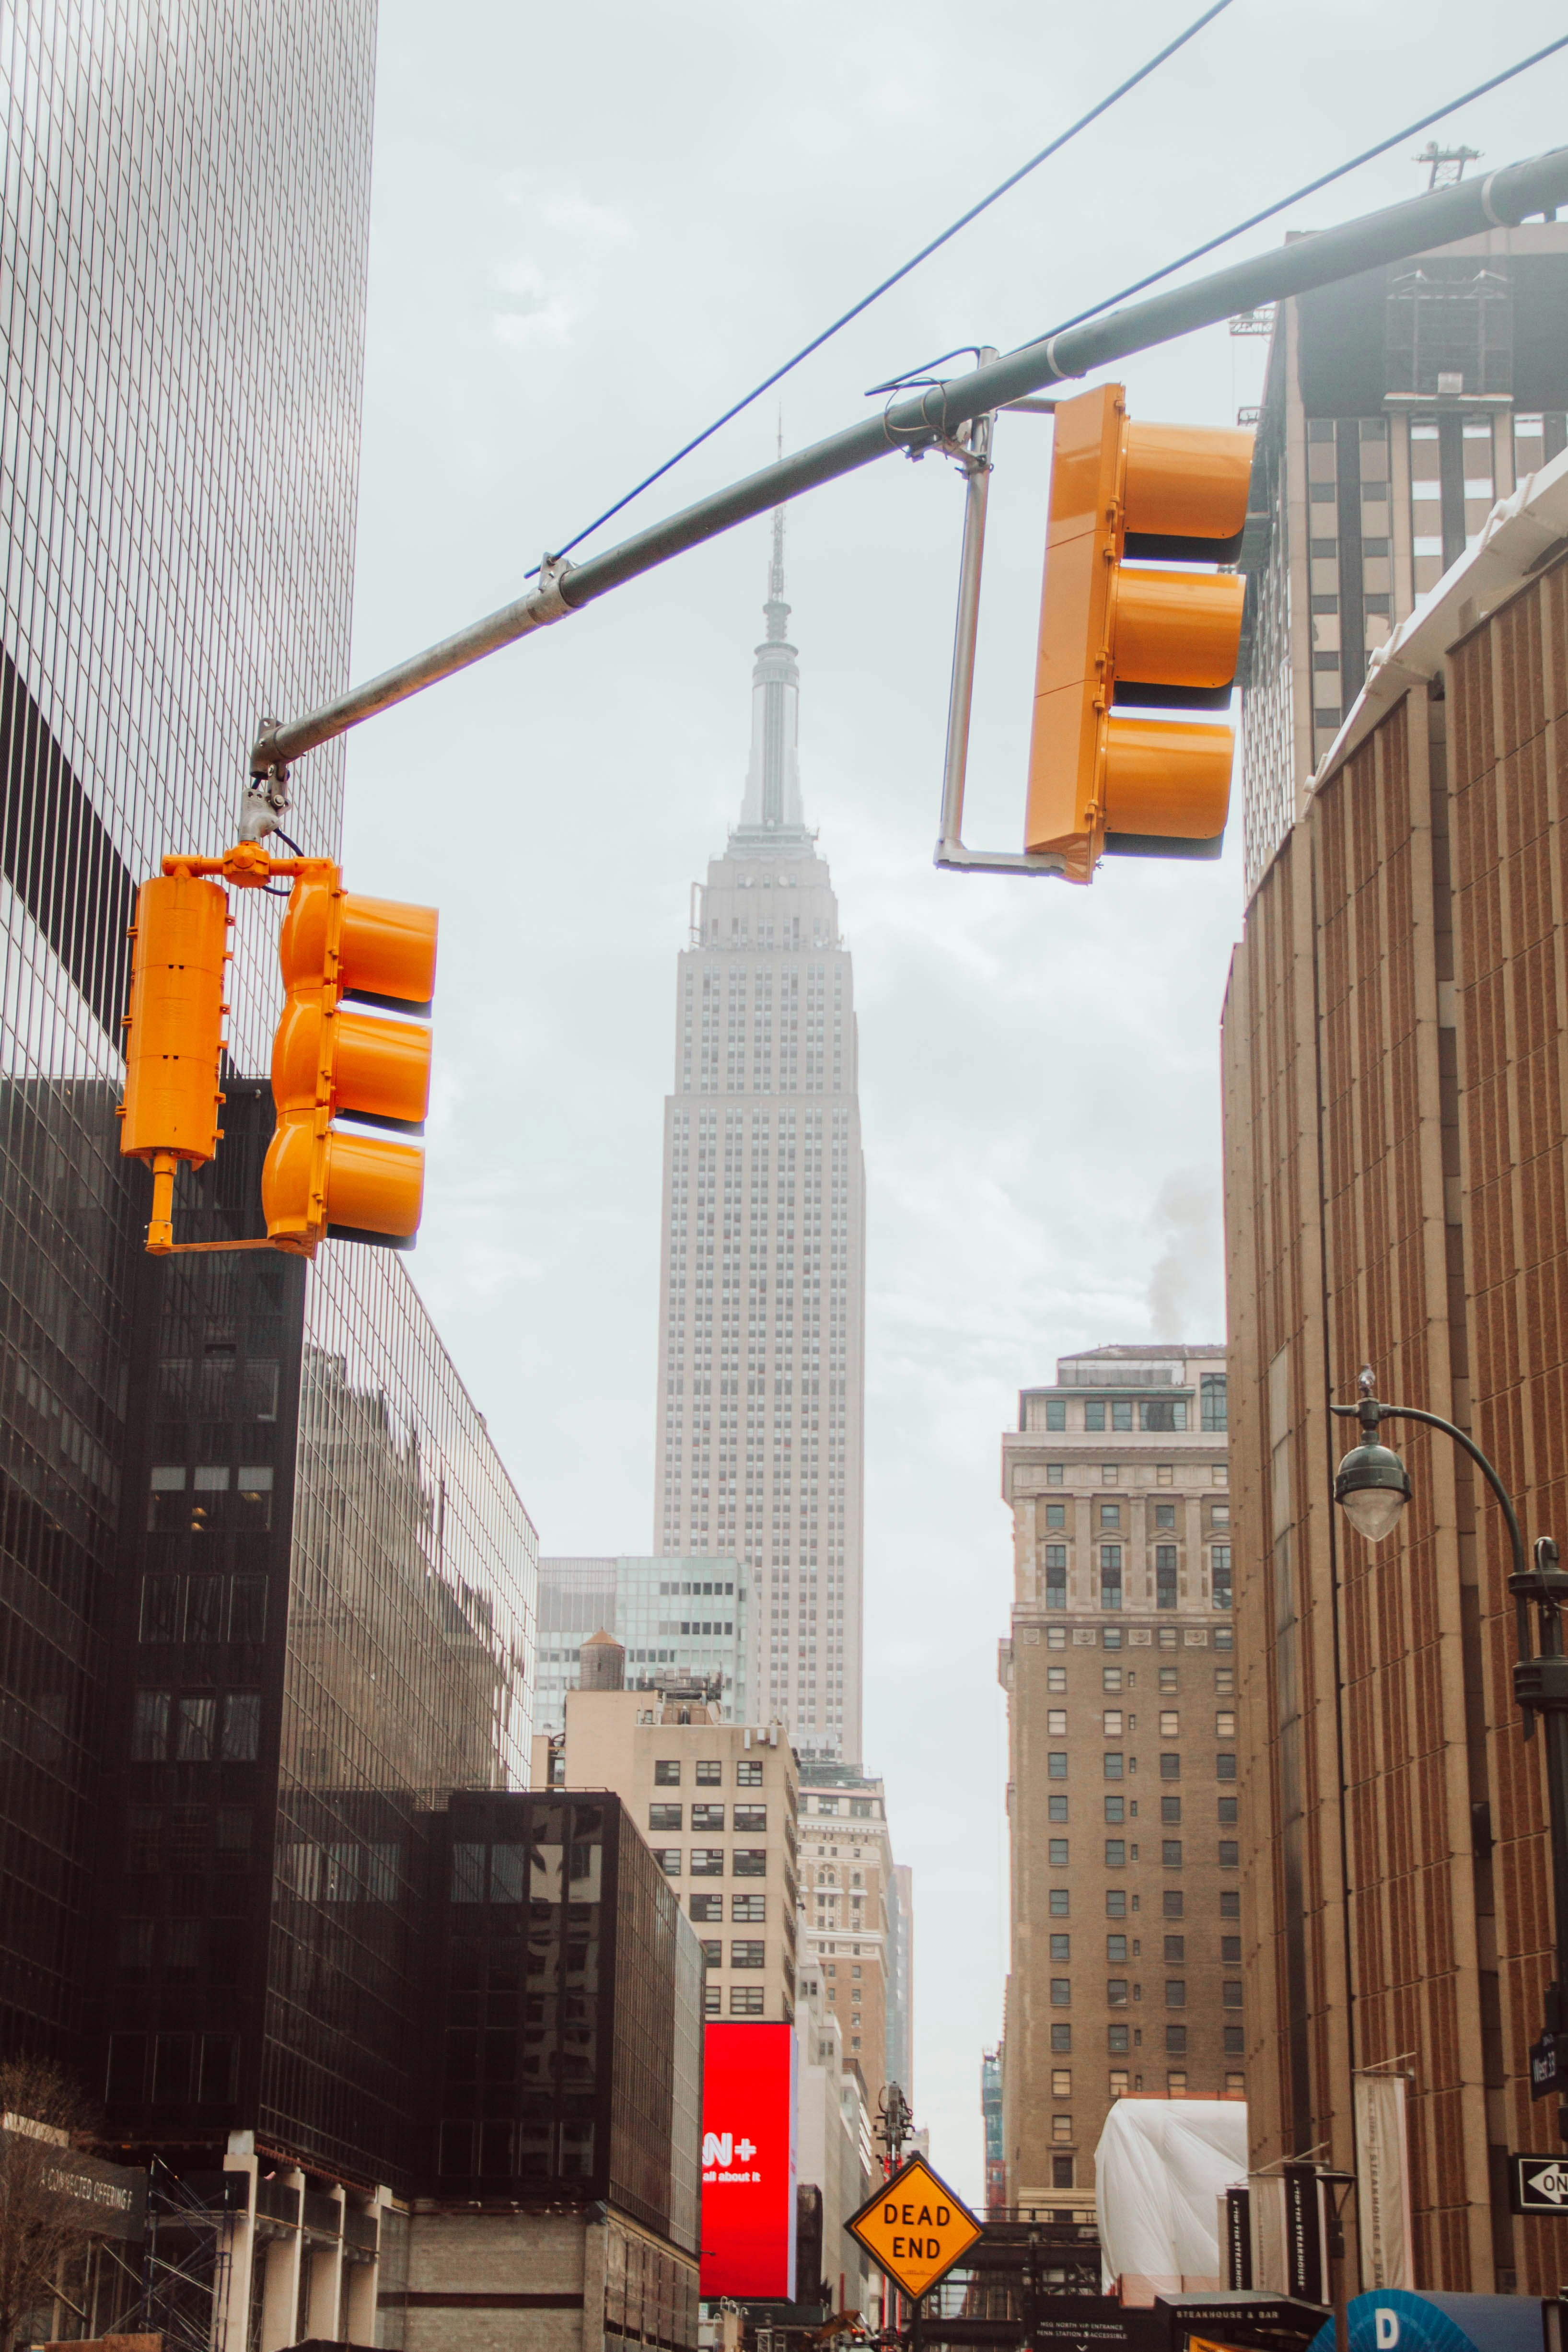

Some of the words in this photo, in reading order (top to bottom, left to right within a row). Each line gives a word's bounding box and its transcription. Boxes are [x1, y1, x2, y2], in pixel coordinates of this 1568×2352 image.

[1533, 2057, 1547, 2083] West
[703, 2171, 717, 2182] all
[718, 2171, 750, 2182] about
[752, 2171, 761, 2182] it
[93, 2182, 127, 2210] OFFERING
[1370, 2154, 1381, 2239] STEAKHOUSE
[884, 2203, 950, 2226] DEAD
[893, 2236, 940, 2259] END
[1176, 2310, 1242, 2318] STEAKHOUSE
[1247, 2310, 1254, 2318] &
[1375, 2307, 1399, 2349] D
